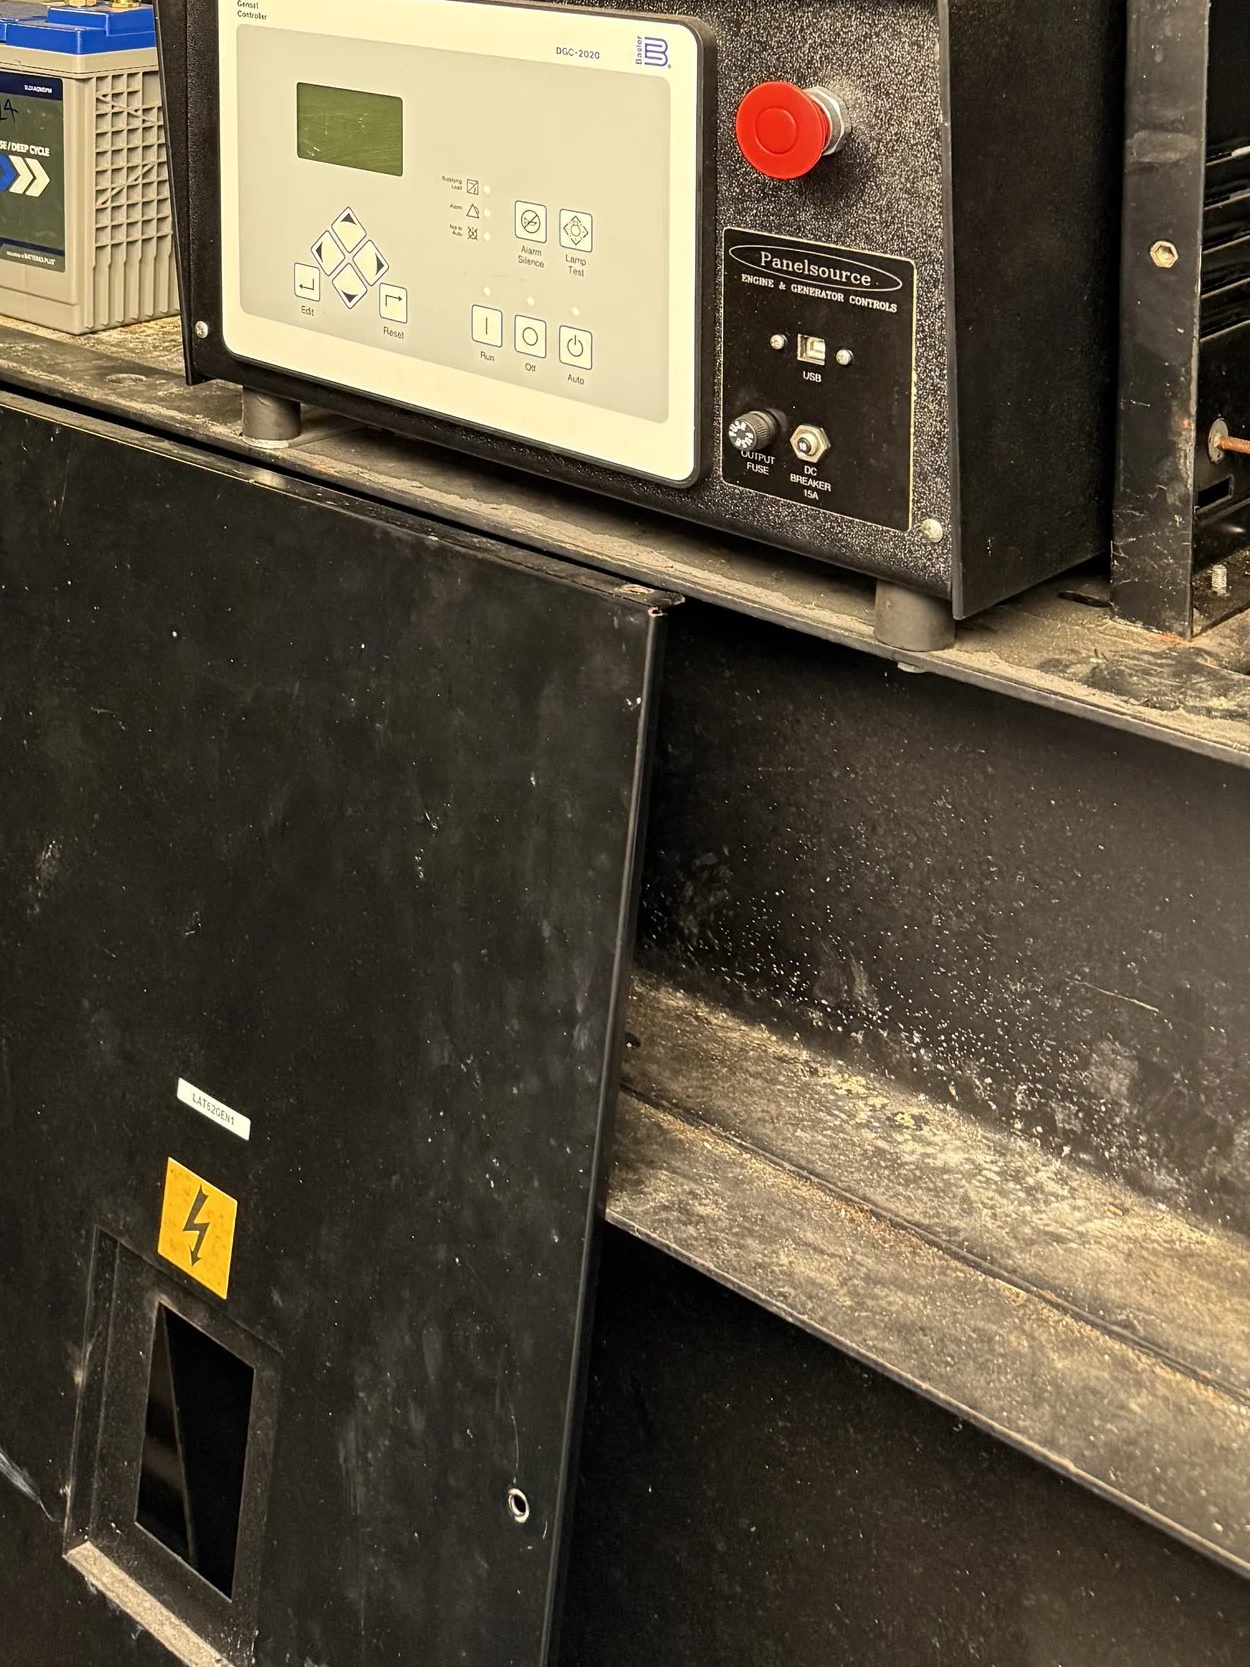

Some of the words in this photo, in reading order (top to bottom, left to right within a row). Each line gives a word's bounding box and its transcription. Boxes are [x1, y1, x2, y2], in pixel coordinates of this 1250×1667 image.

[237, 10, 267, 20] Controller
[555, 46, 600, 60] DGC-2020
[11, 143, 29, 153] DEEP
[30, 145, 50, 157] CYCLE
[520, 245, 542, 256] Alarm
[517, 255, 545, 268] Silence
[565, 254, 587, 266] Lamp
[568, 266, 585, 277] Test
[760, 251, 872, 286] Panelsource
[741, 274, 774, 288] ENGINE
[778, 281, 786, 291] &
[790, 284, 845, 303] GENERATOR
[849, 295, 898, 313] CONTROLS
[301, 305, 315, 316] Edit
[383, 326, 405, 340] Reset
[480, 350, 495, 362] Run
[524, 362, 536, 372] Off
[567, 374, 585, 385] Auto
[802, 370, 822, 383] USB
[740, 449, 776, 465] OUTPUT
[746, 461, 770, 475] FUSE
[804, 465, 817, 477] DC
[790, 474, 831, 492] BREAKER
[803, 489, 819, 500] 15A
[191, 1092, 235, 1126] LAT62GEN1
